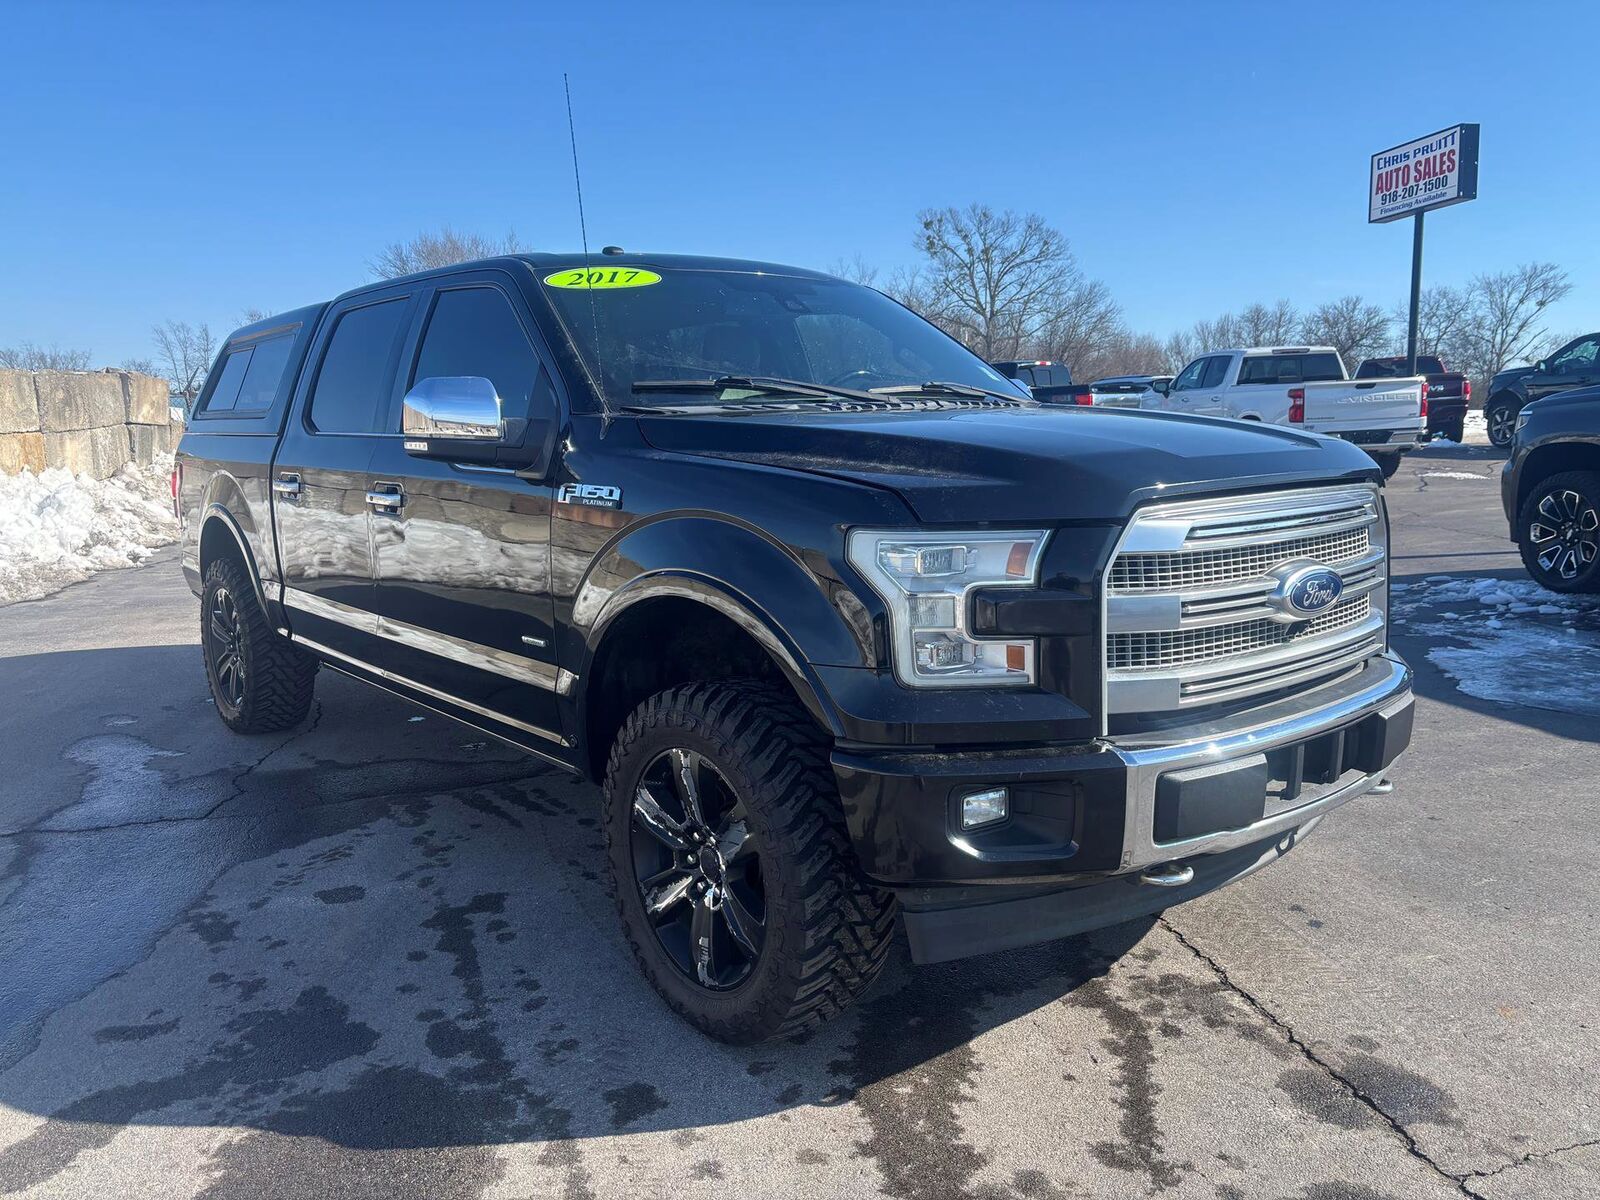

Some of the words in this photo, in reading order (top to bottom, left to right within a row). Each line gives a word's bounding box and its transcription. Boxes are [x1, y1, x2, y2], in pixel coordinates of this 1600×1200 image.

[1376, 151, 1410, 170] CHRIS
[1413, 131, 1457, 158] PRUITT
[1375, 164, 1411, 195] AUTO
[1413, 149, 1456, 183] SALES
[1381, 175, 1448, 205] 918-207-1500
[1380, 202, 1413, 215] Financing
[567, 271, 639, 286] 2017
[582, 498, 613, 507] PLATINUM
[1303, 580, 1334, 607] Ford
